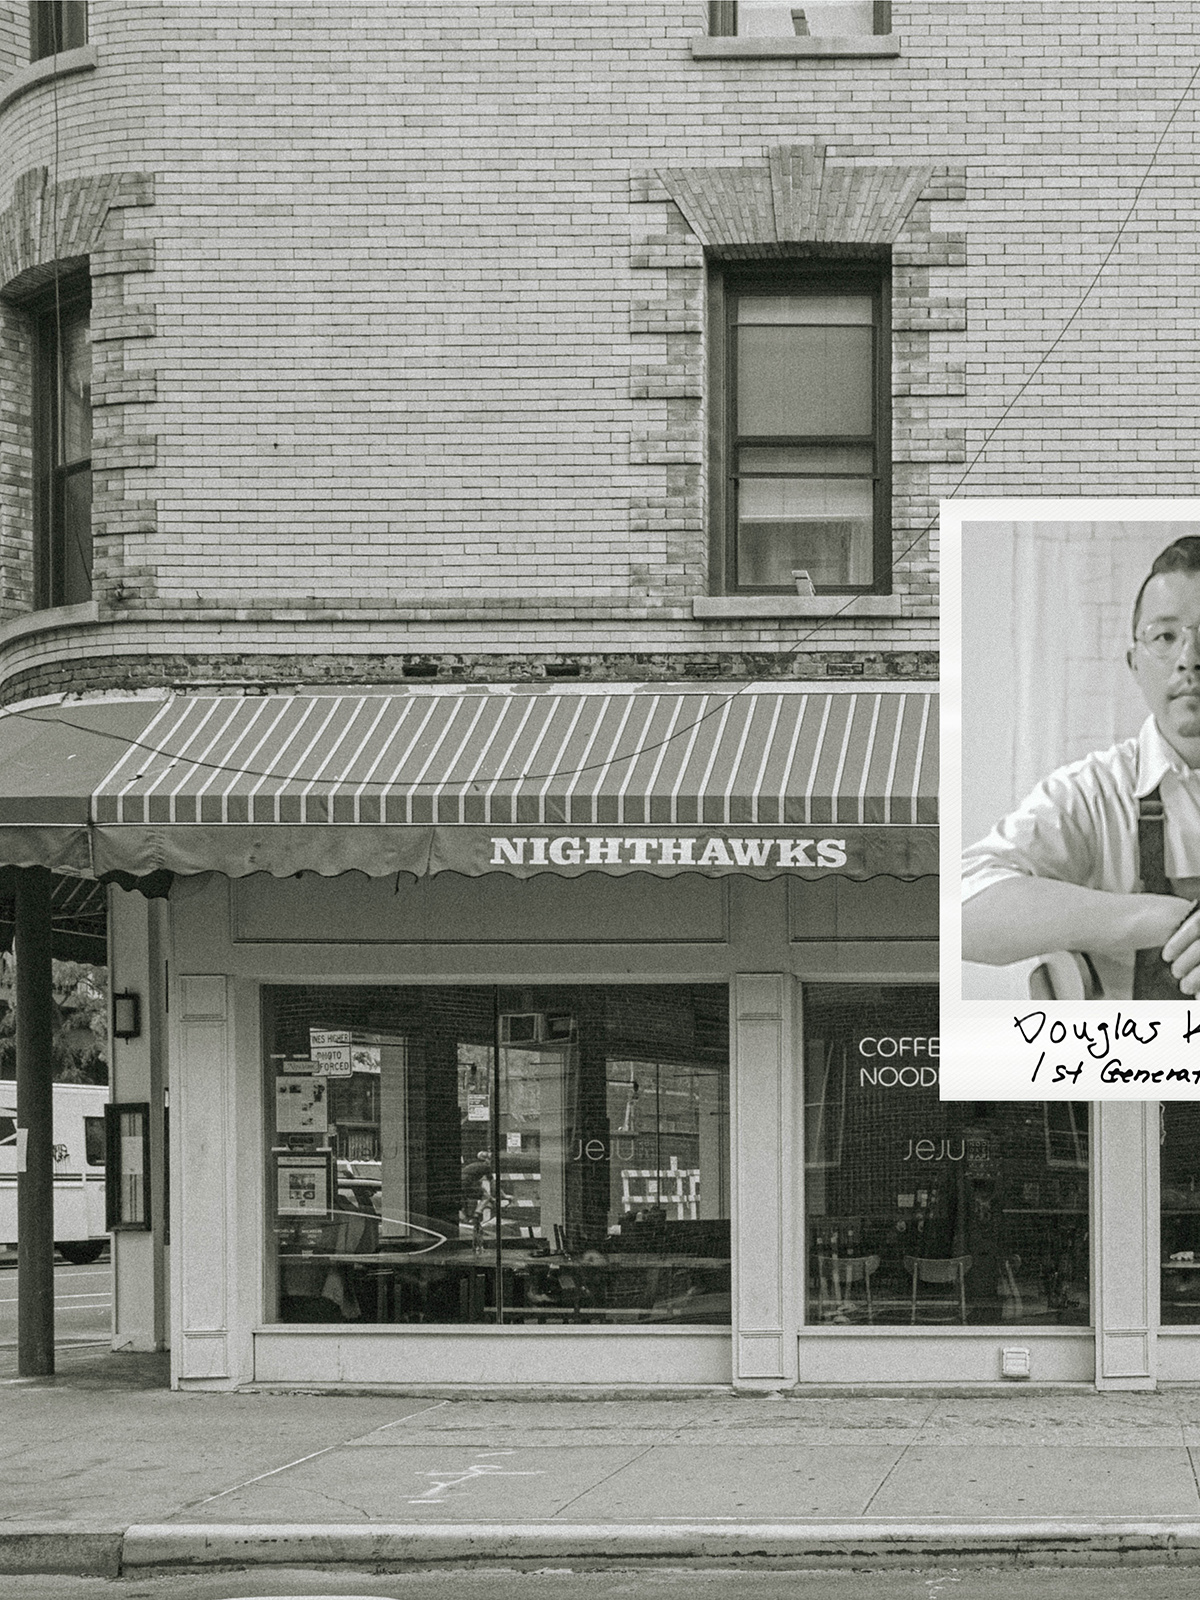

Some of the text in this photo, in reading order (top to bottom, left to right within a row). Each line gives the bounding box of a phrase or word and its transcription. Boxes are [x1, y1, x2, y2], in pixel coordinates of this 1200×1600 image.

[490, 837, 847, 867] NIGHTHAWKS
[316, 1051, 342, 1060] PHOTO
[860, 1066, 940, 1087] NOOD
